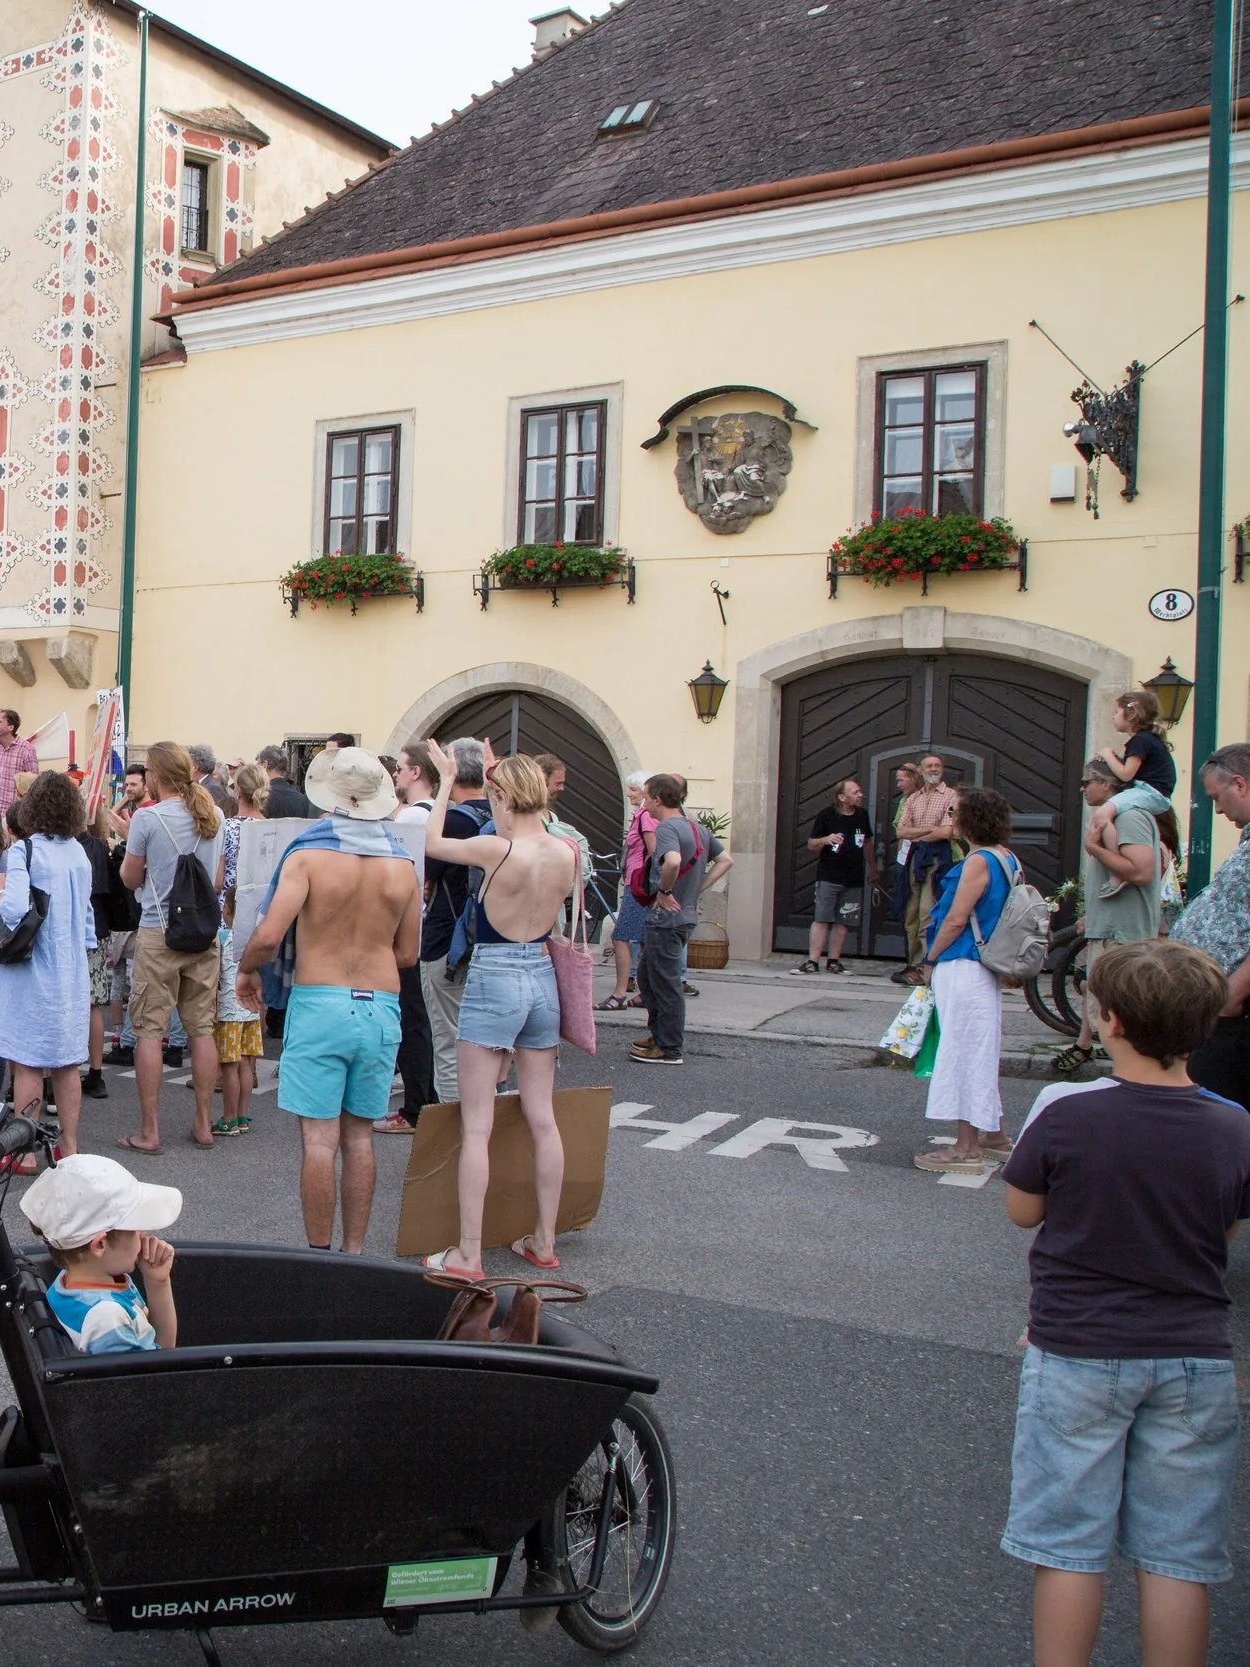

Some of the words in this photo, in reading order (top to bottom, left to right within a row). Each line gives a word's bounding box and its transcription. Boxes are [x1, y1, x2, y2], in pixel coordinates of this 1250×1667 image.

[1166, 593, 1177, 611] 8
[390, 1578, 416, 1586] Wiener
[131, 1600, 209, 1619] URBAN
[213, 1592, 297, 1613] ARROW
